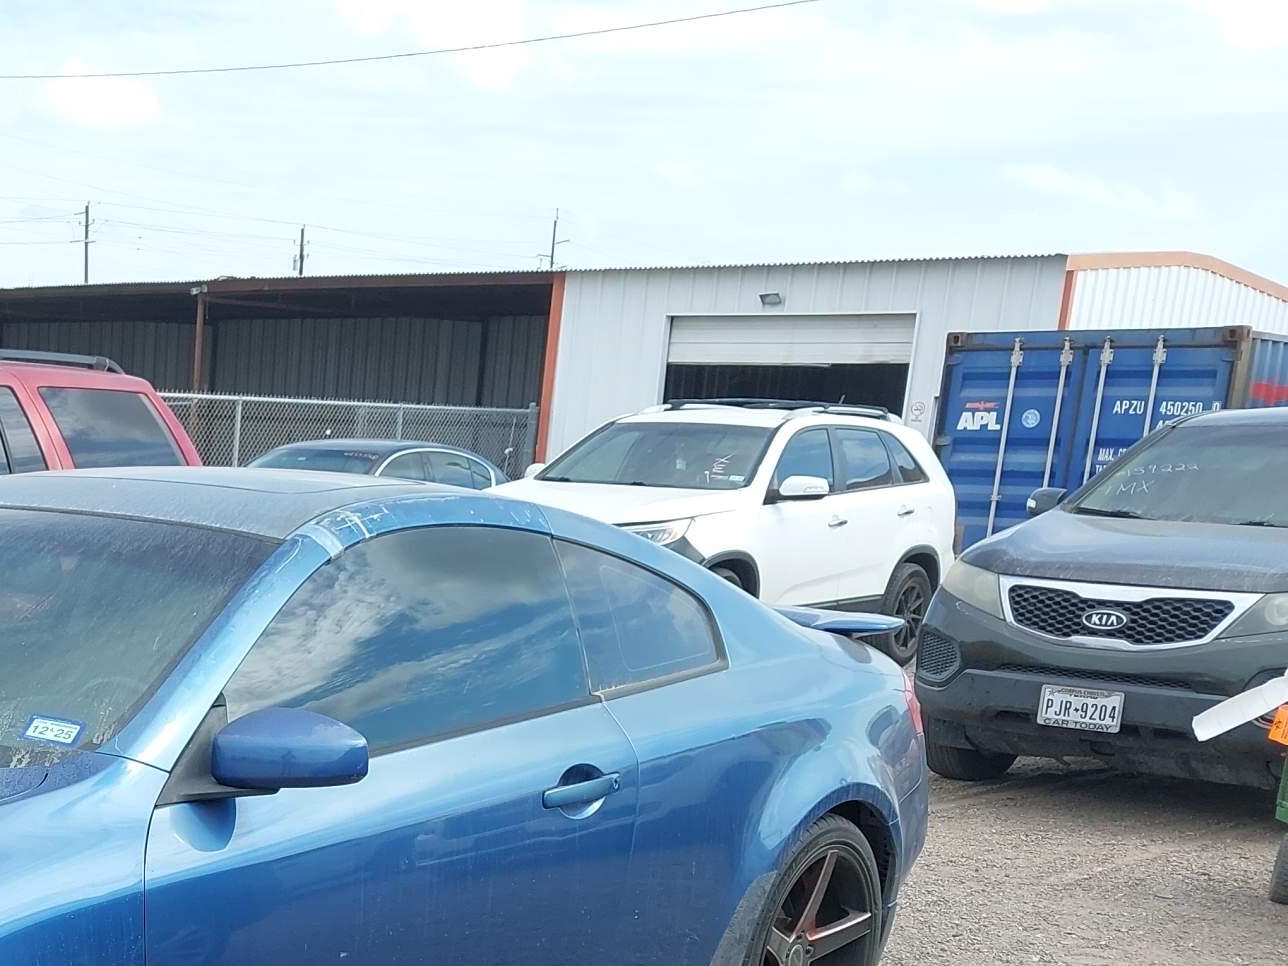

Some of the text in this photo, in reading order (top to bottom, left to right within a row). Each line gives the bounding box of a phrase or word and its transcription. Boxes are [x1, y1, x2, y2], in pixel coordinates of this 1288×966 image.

[1113, 400, 1145, 415] APZU
[956, 411, 1001, 430] APL
[1091, 613, 1118, 626] KIA
[1044, 718, 1112, 731] CAR TODAY
